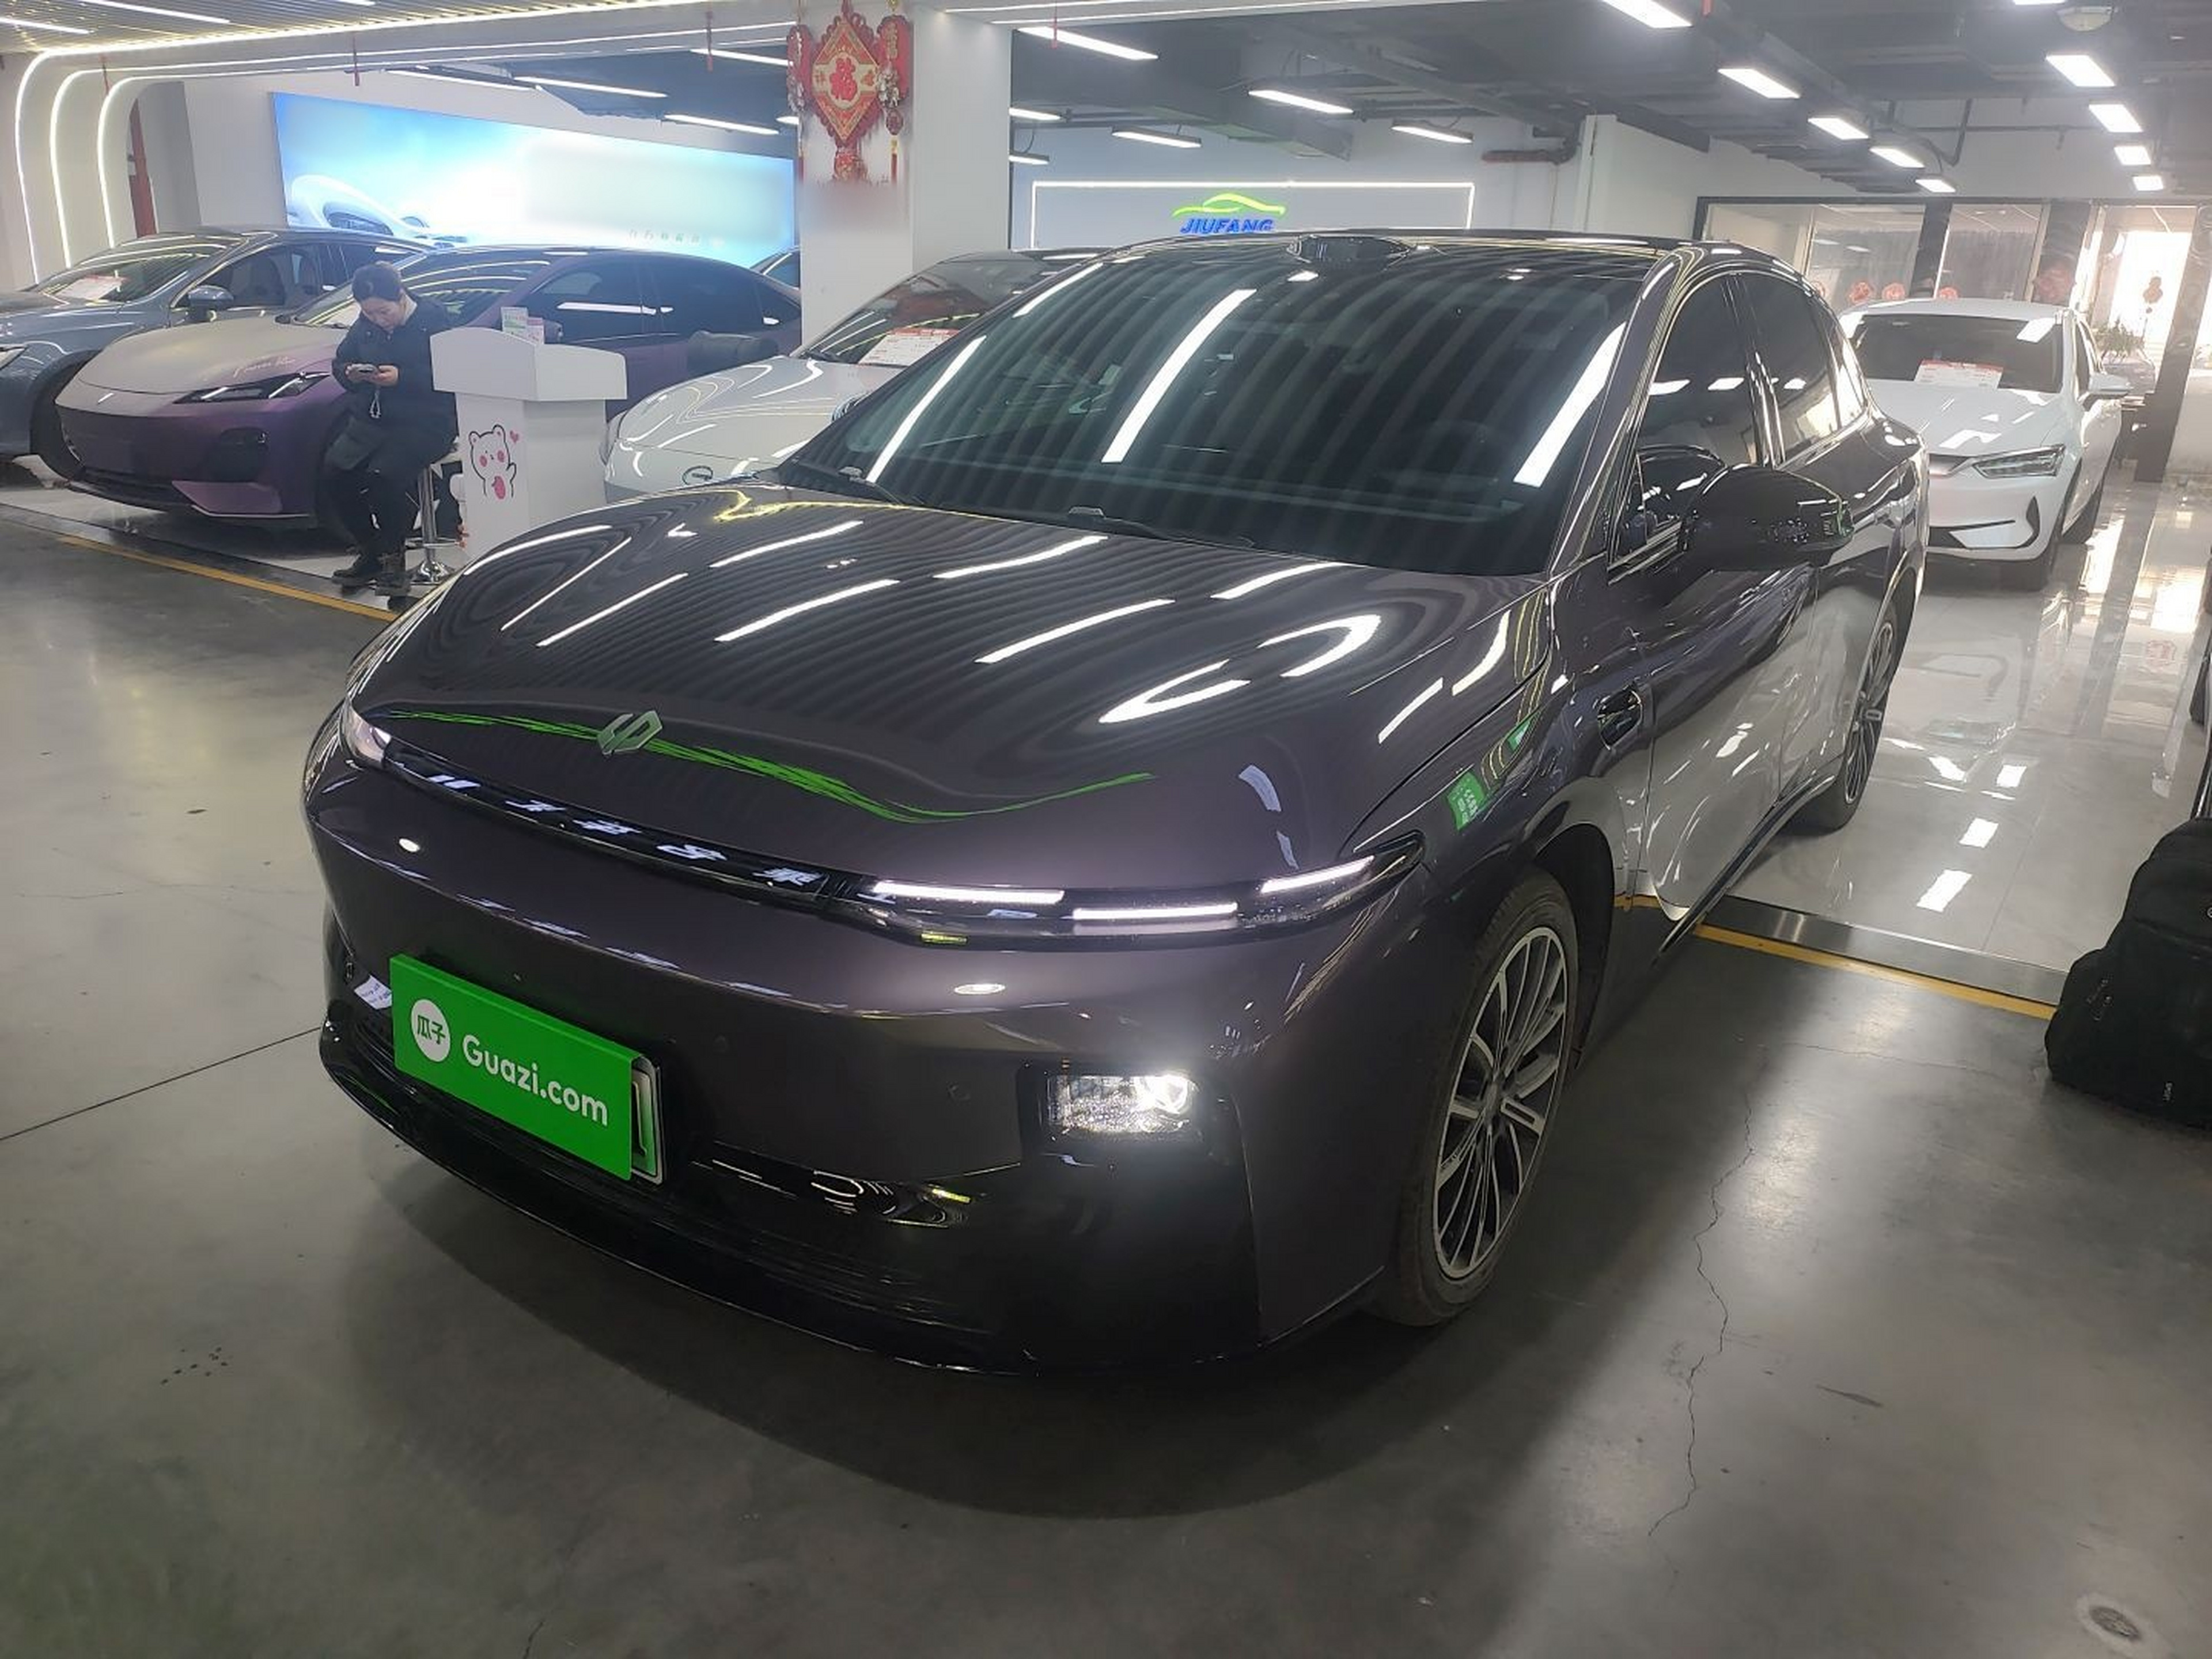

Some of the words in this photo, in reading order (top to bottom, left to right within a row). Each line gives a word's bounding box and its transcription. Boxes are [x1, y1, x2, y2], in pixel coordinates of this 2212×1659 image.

[1180, 218, 1273, 233] JIUFANG
[418, 1015, 446, 1044] 瓜子
[463, 1035, 608, 1126] Guazi.com
